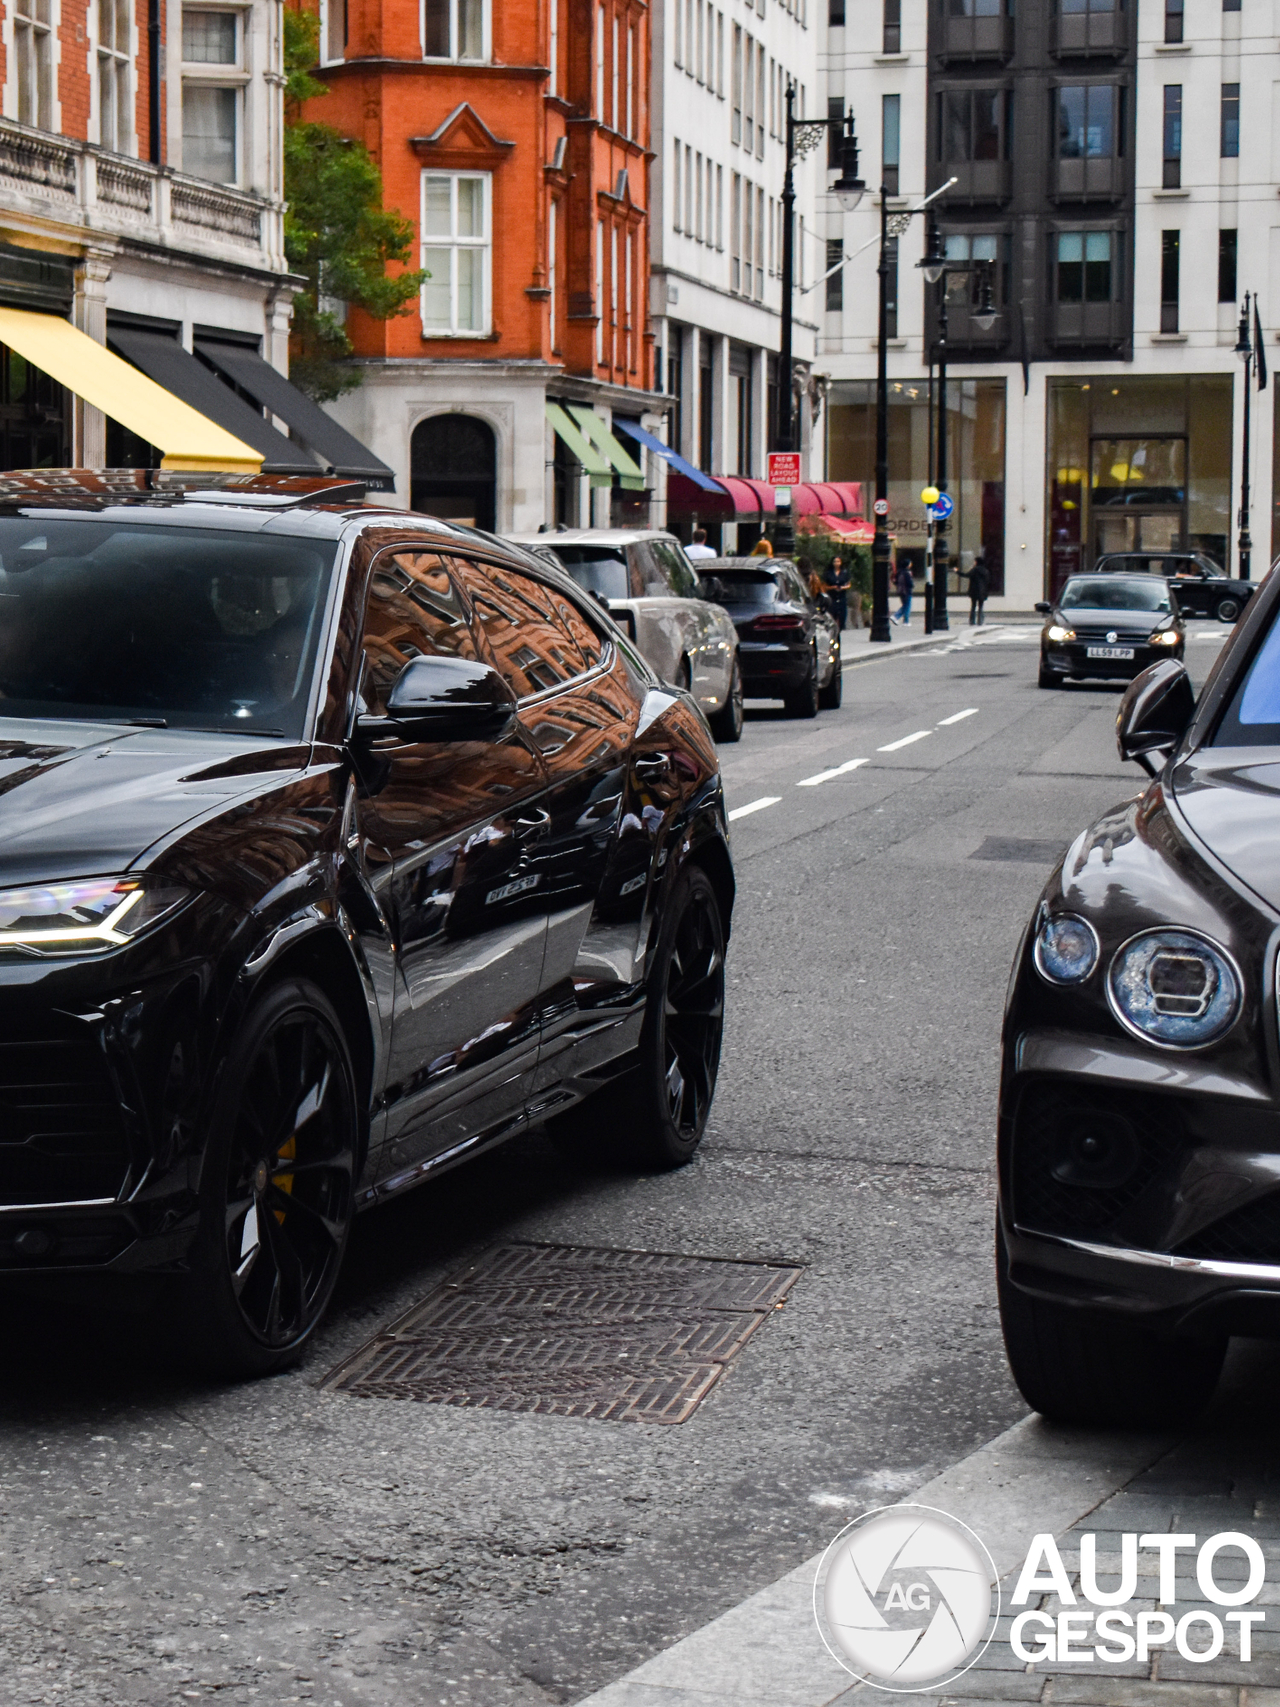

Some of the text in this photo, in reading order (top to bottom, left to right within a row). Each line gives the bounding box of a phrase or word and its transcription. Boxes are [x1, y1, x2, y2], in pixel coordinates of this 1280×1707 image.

[875, 503, 888, 511] 20
[1091, 649, 1131, 658] LL59 LPP
